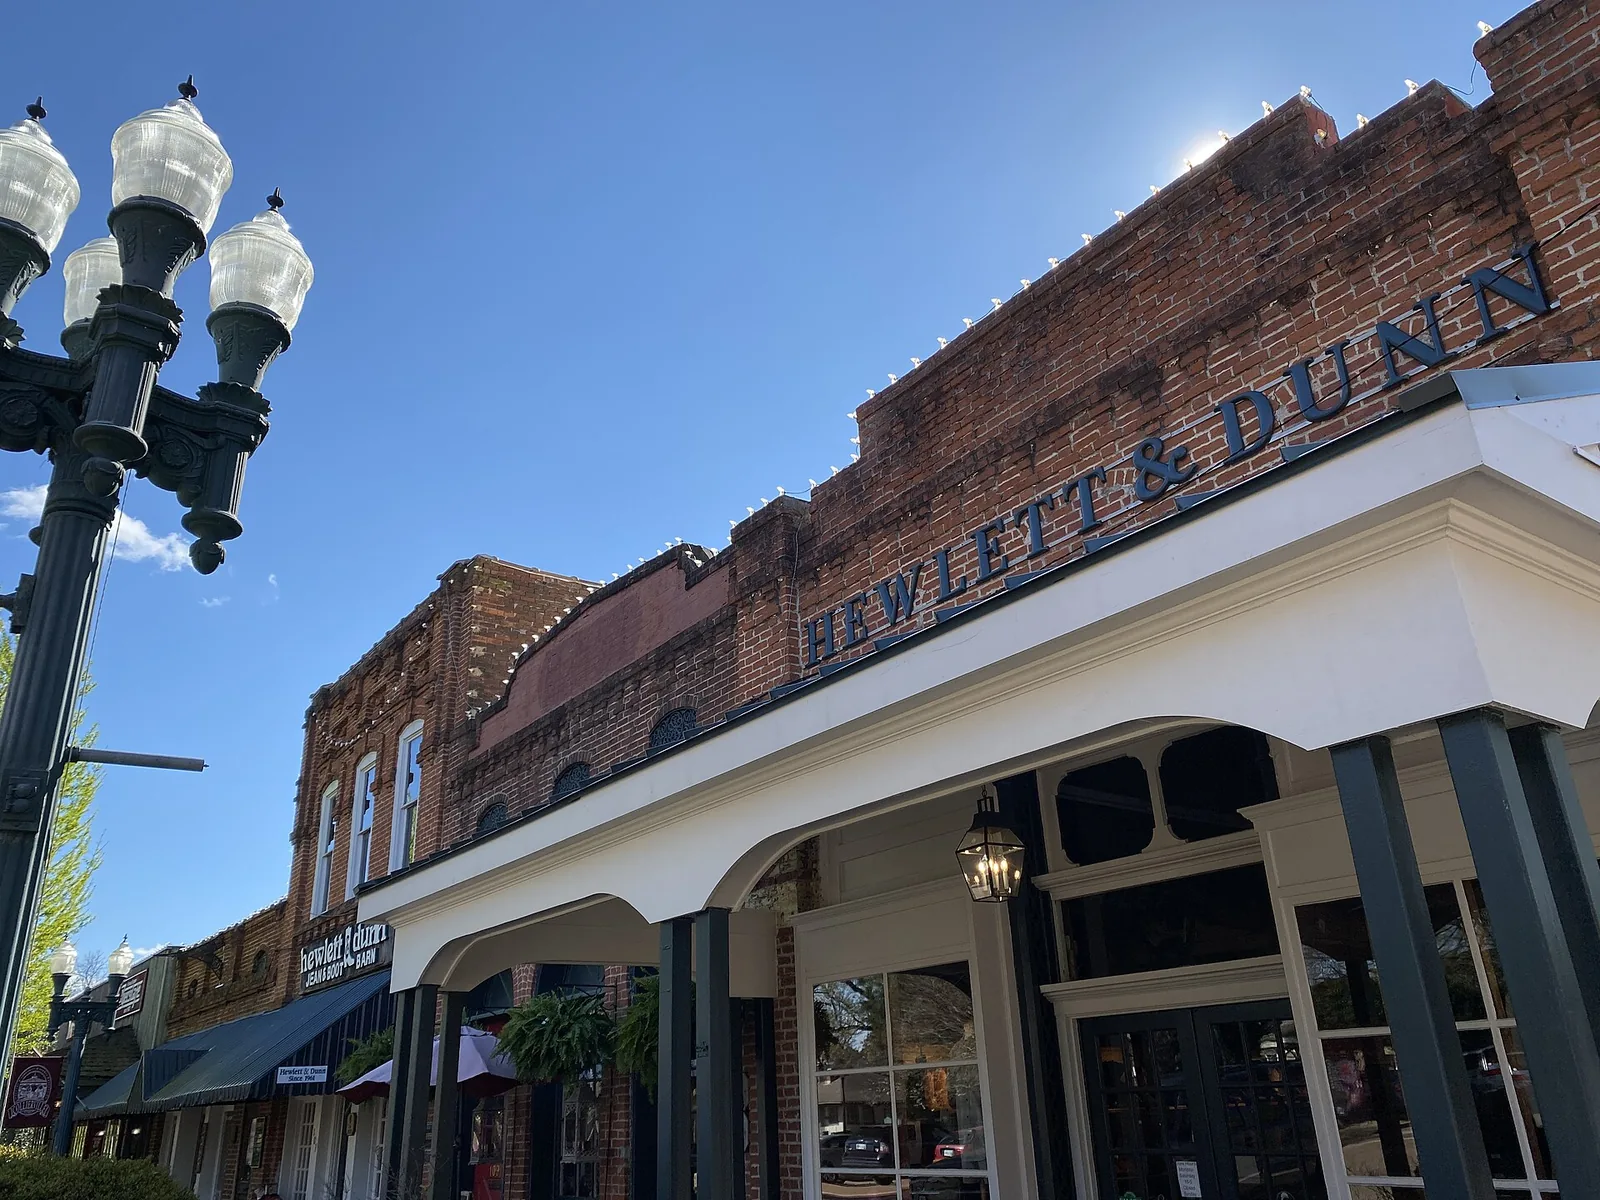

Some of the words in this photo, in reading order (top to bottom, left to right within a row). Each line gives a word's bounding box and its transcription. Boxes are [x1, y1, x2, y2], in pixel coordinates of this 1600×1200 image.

[803, 466, 1106, 669] HEWLETT
[1132, 436, 1197, 501] &
[1214, 243, 1553, 465] DUNN
[300, 933, 343, 974] hewlett
[352, 923, 386, 952] dunn
[305, 969, 323, 988] JEAN
[326, 961, 344, 981] BOOT
[355, 947, 376, 970] BARN
